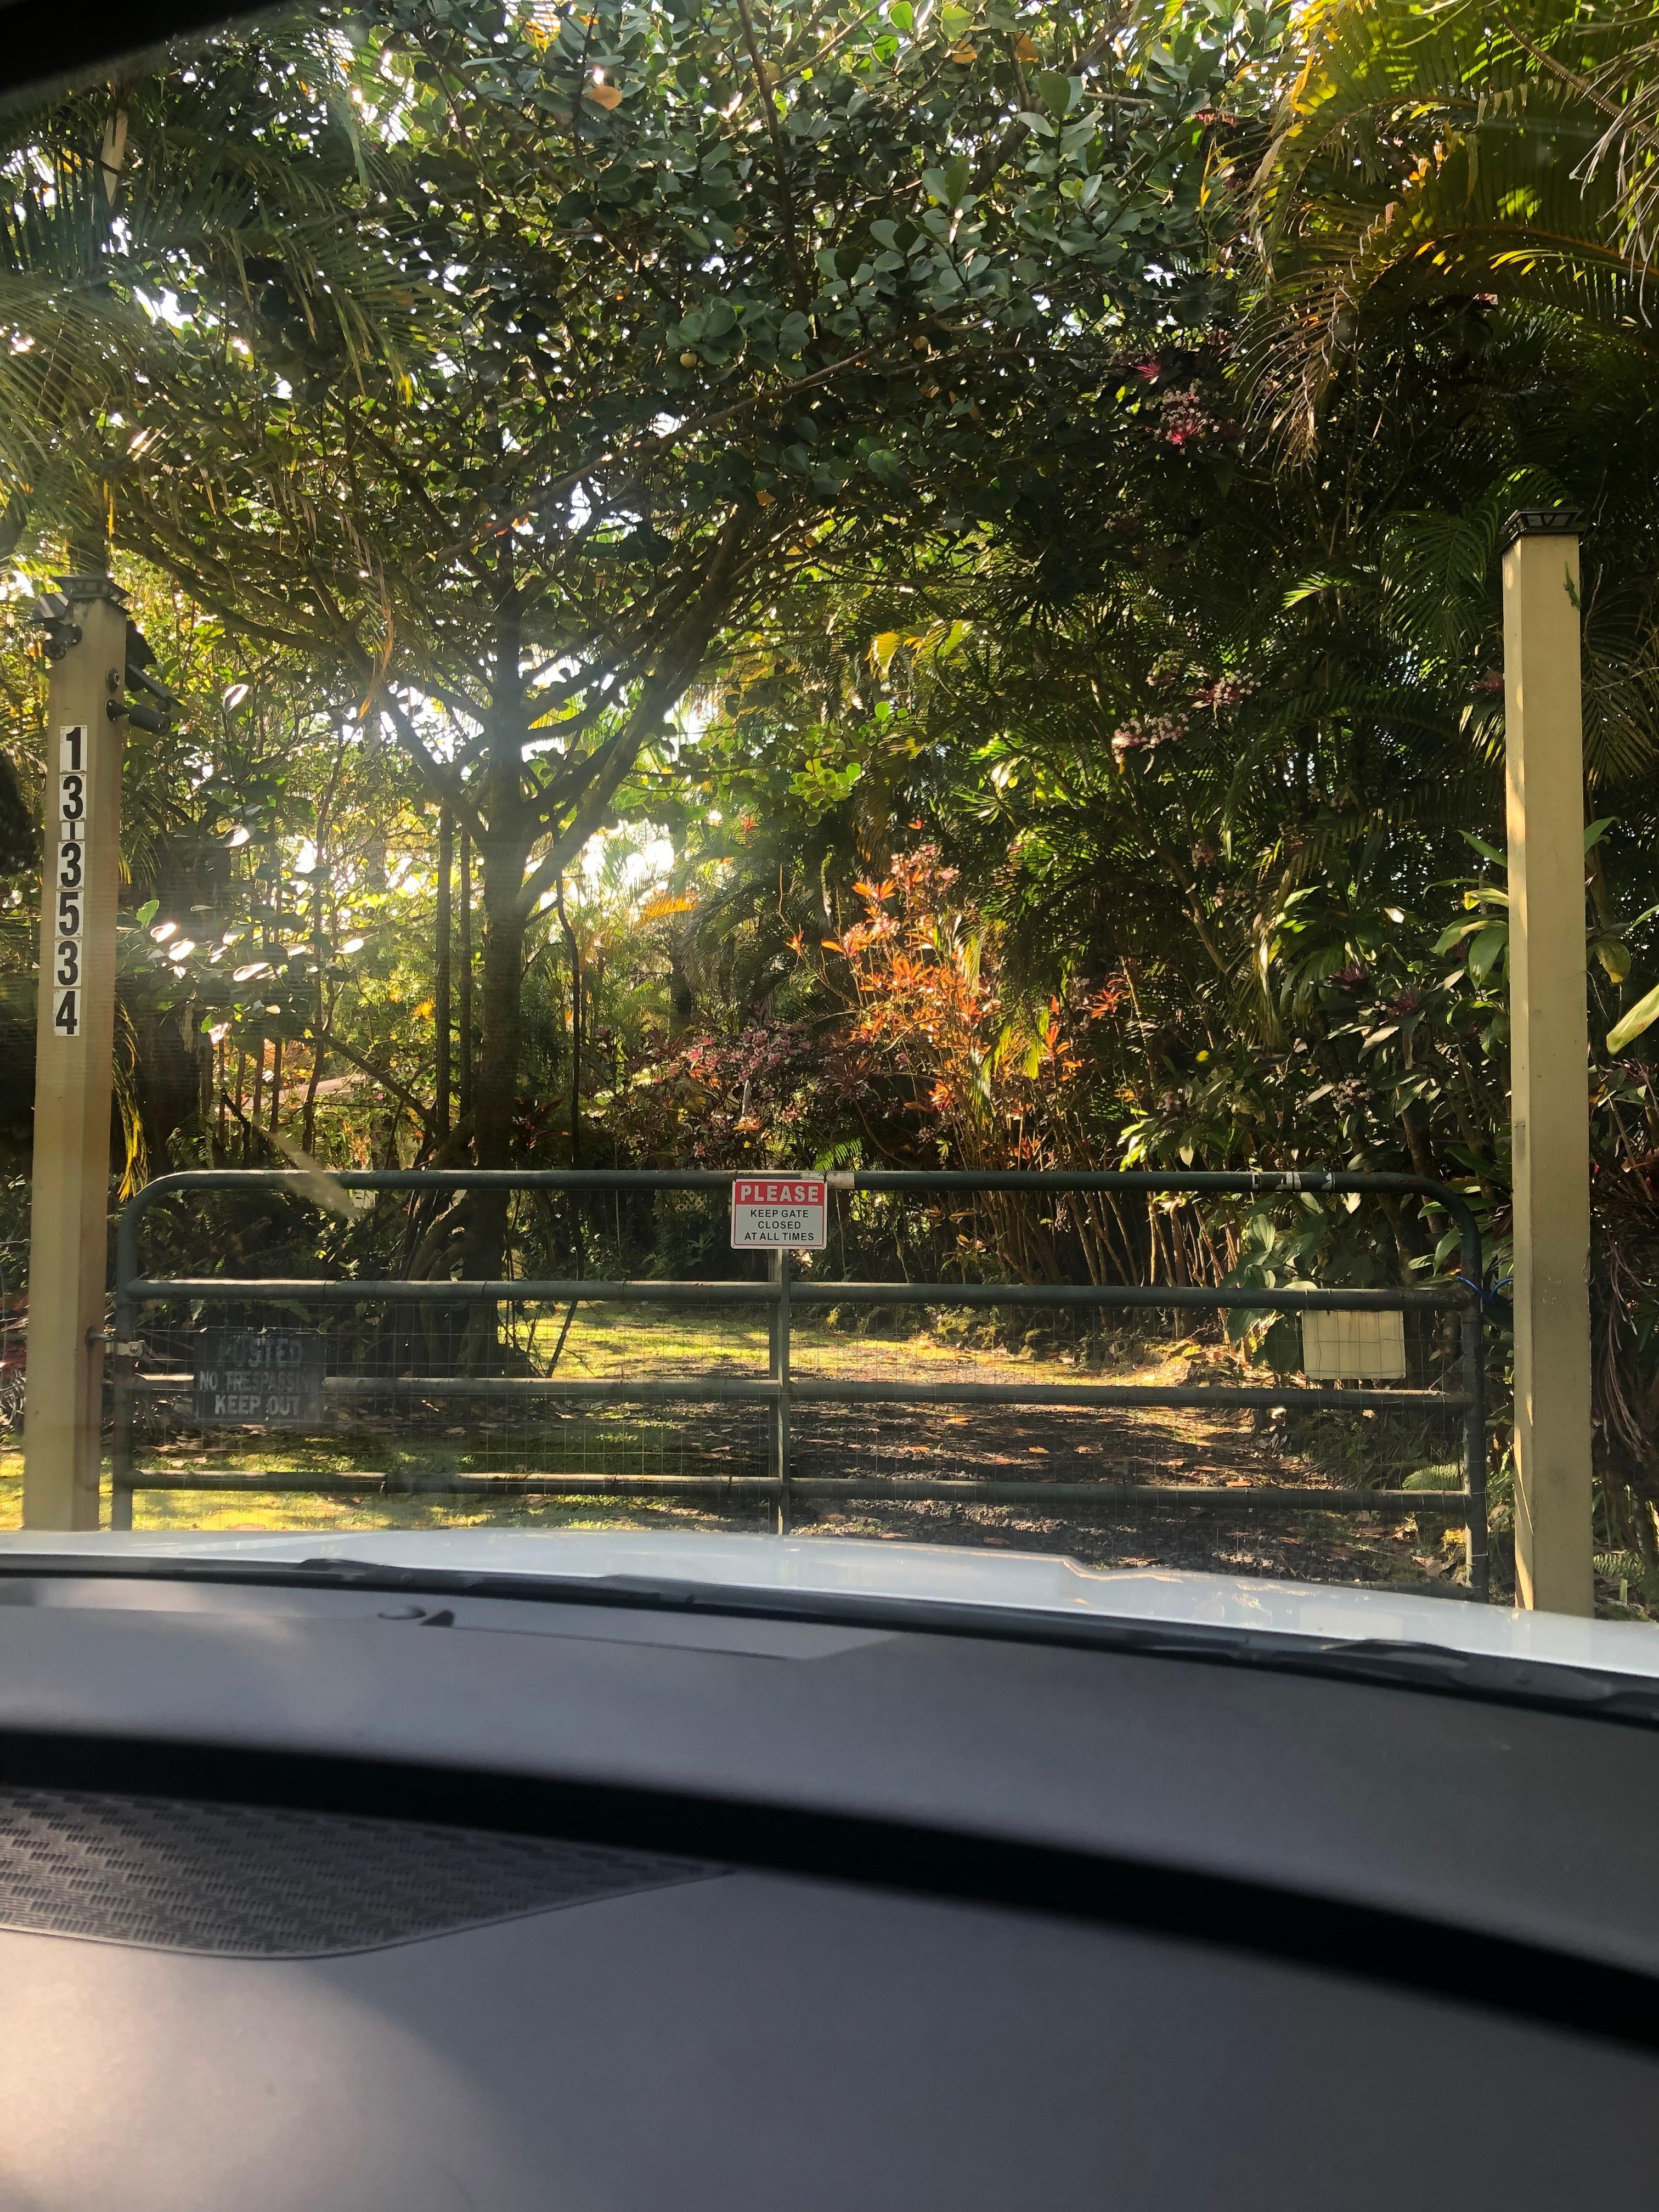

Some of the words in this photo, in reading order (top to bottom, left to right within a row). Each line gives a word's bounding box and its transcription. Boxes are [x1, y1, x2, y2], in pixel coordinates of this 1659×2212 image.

[741, 1185, 819, 1203] PLEASE
[751, 1209, 778, 1217] KEEP
[781, 1210, 809, 1218] GATE
[758, 1221, 801, 1229] CLOSED
[744, 1232, 757, 1240] AT
[759, 1232, 780, 1240] ALL
[782, 1233, 814, 1241] TIMES
[199, 1370, 219, 1391] NO
[215, 1394, 261, 1415] KEEP
[267, 1395, 301, 1416] OUT
